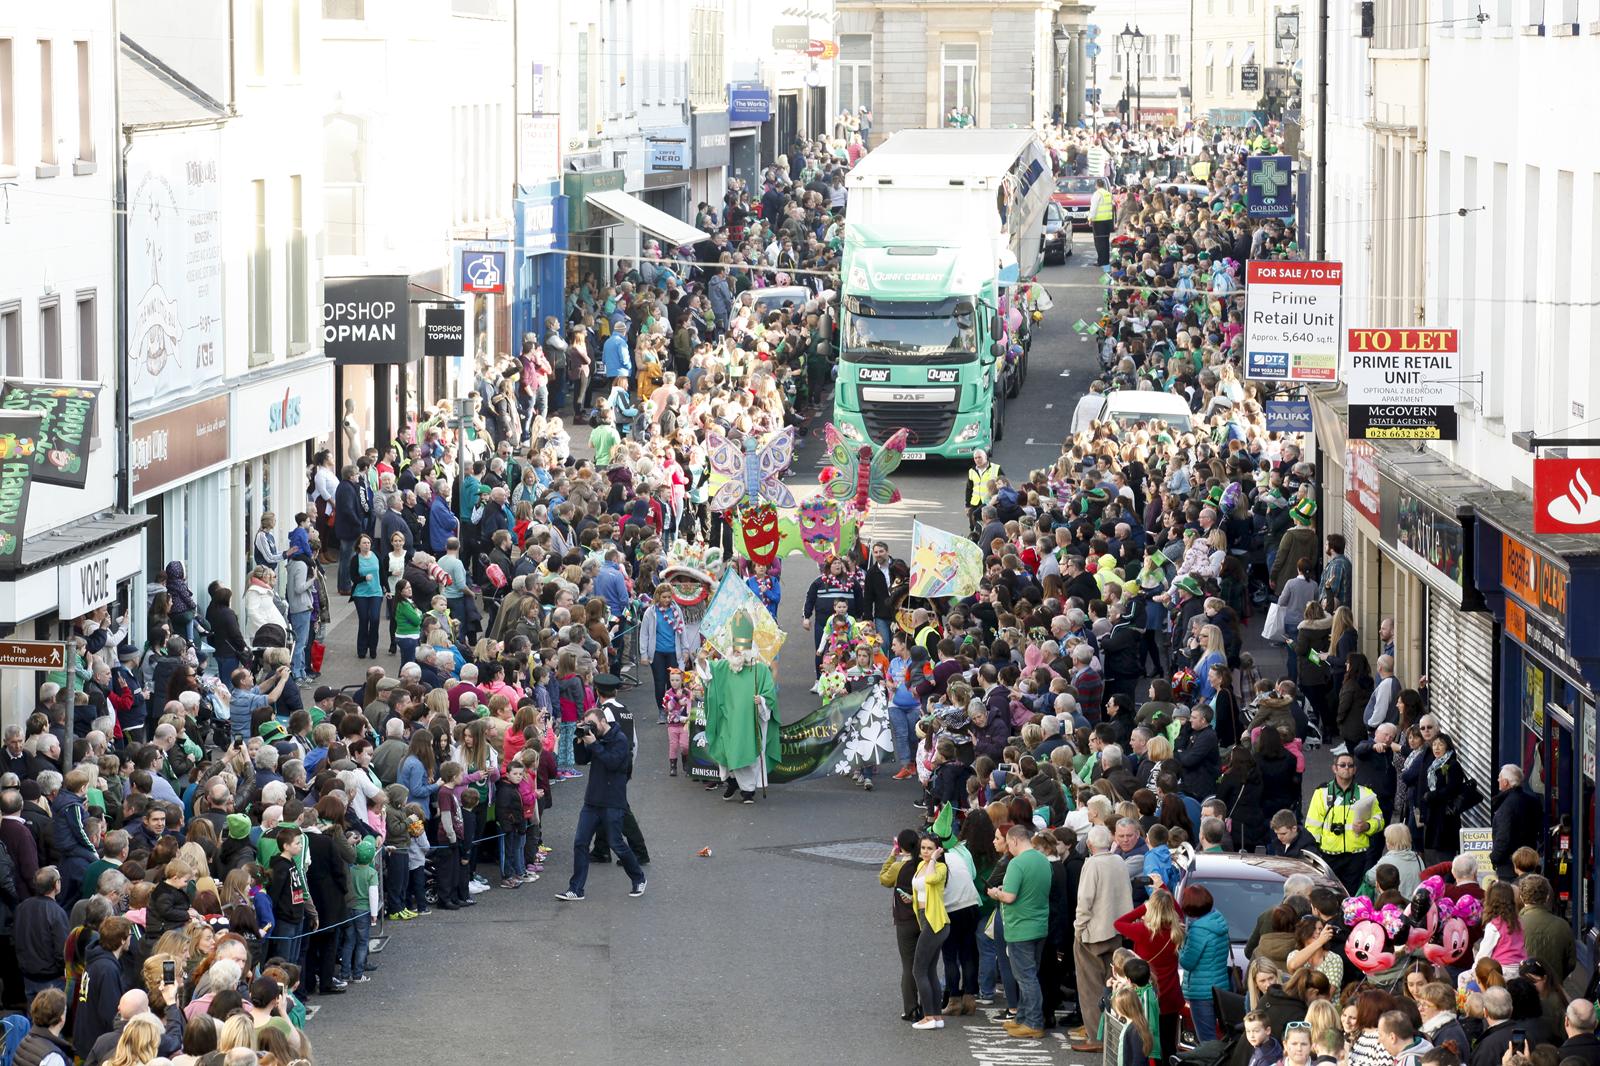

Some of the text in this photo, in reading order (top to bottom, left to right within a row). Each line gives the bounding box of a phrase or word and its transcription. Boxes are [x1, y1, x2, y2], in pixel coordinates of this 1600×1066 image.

[1258, 268, 1276, 277] FOR
[1279, 269, 1302, 278] SALE
[1311, 270, 1324, 278] TO
[1327, 270, 1340, 278] LET
[1272, 292, 1316, 305] Prime
[324, 302, 395, 320] OPSHOP
[1254, 312, 1334, 326] Retail Unit
[324, 324, 395, 342] OPMAN
[1252, 333, 1280, 342] Approx.
[1282, 332, 1314, 342] 5,640
[1354, 331, 1452, 350] TO LET
[1354, 356, 1452, 369] PRIME RETAIL
[859, 368, 890, 380] QUINN
[928, 368, 958, 380] QUINN
[1385, 372, 1420, 384] UNIT
[1369, 407, 1437, 416] McGOVERN
[1417, 512, 1440, 566] style
[80, 558, 109, 606] VOGUE
[12, 646, 26, 654] The
